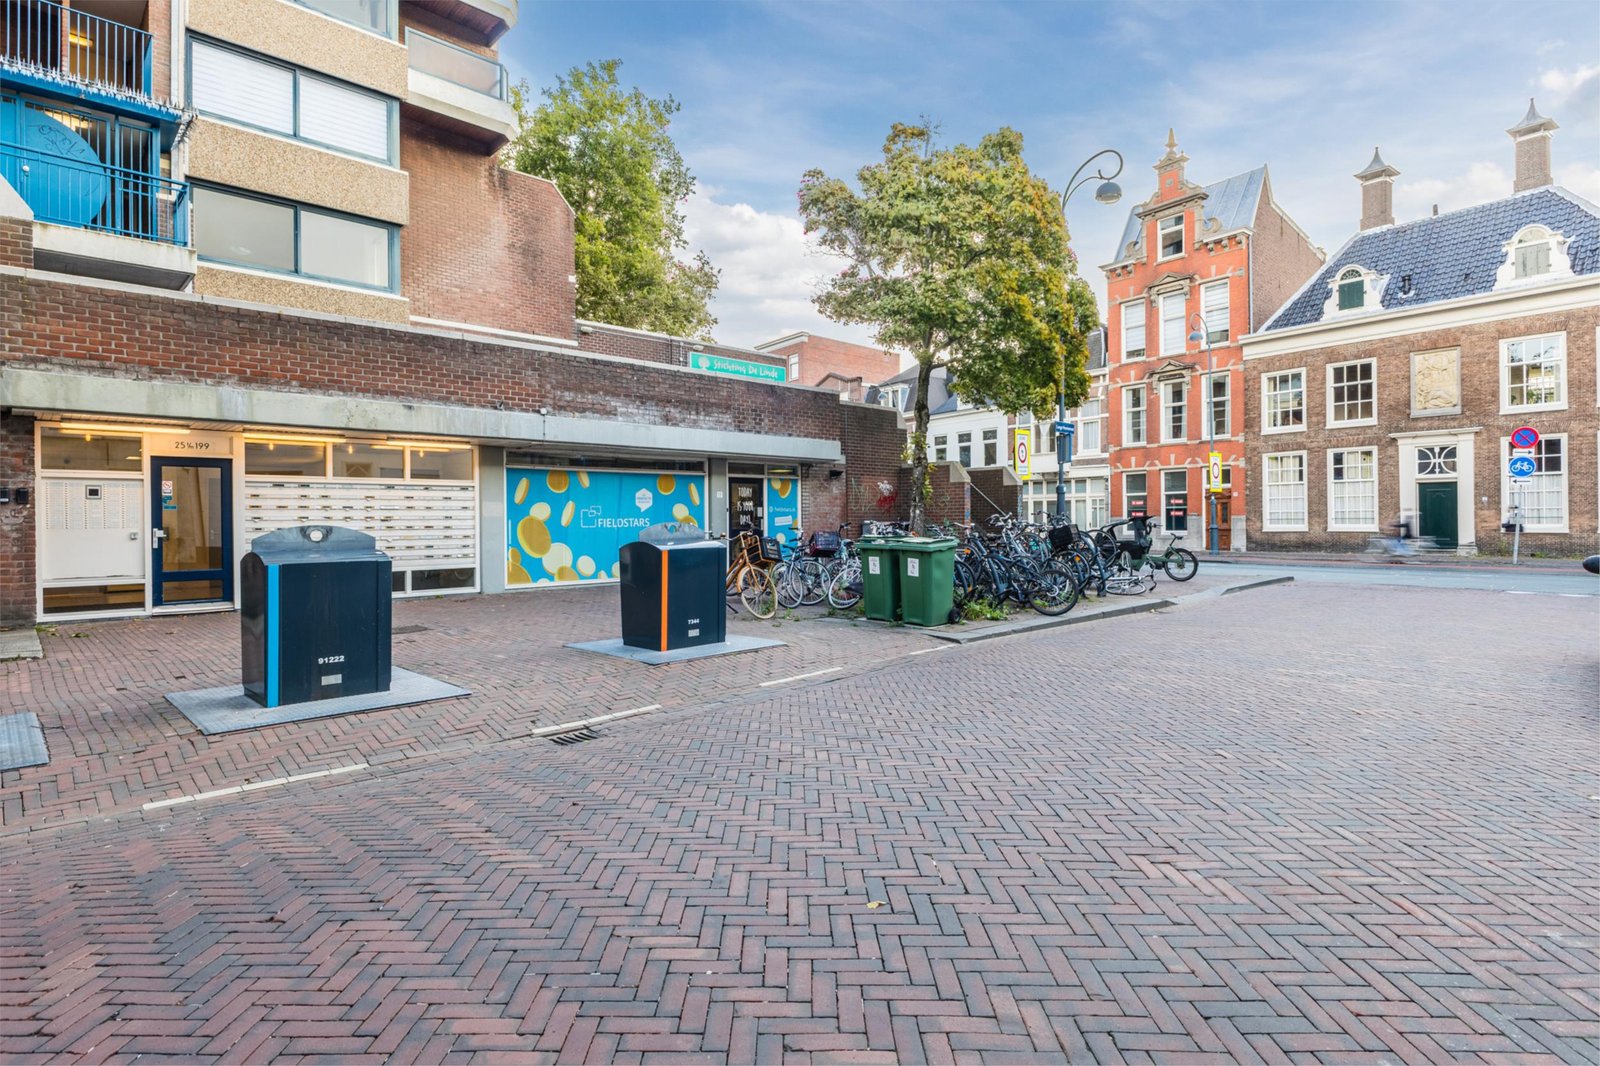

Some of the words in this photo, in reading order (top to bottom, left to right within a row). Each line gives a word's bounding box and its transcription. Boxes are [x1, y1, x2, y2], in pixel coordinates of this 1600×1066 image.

[713, 359, 746, 374] Stichting
[748, 365, 758, 375] De
[759, 367, 778, 378] Linde
[175, 441, 186, 449] 25
[195, 442, 210, 450] 199
[738, 487, 753, 497] TODAY
[737, 501, 742, 511] IS
[598, 518, 650, 528] FIELDSTARS
[318, 655, 345, 665] 91222
